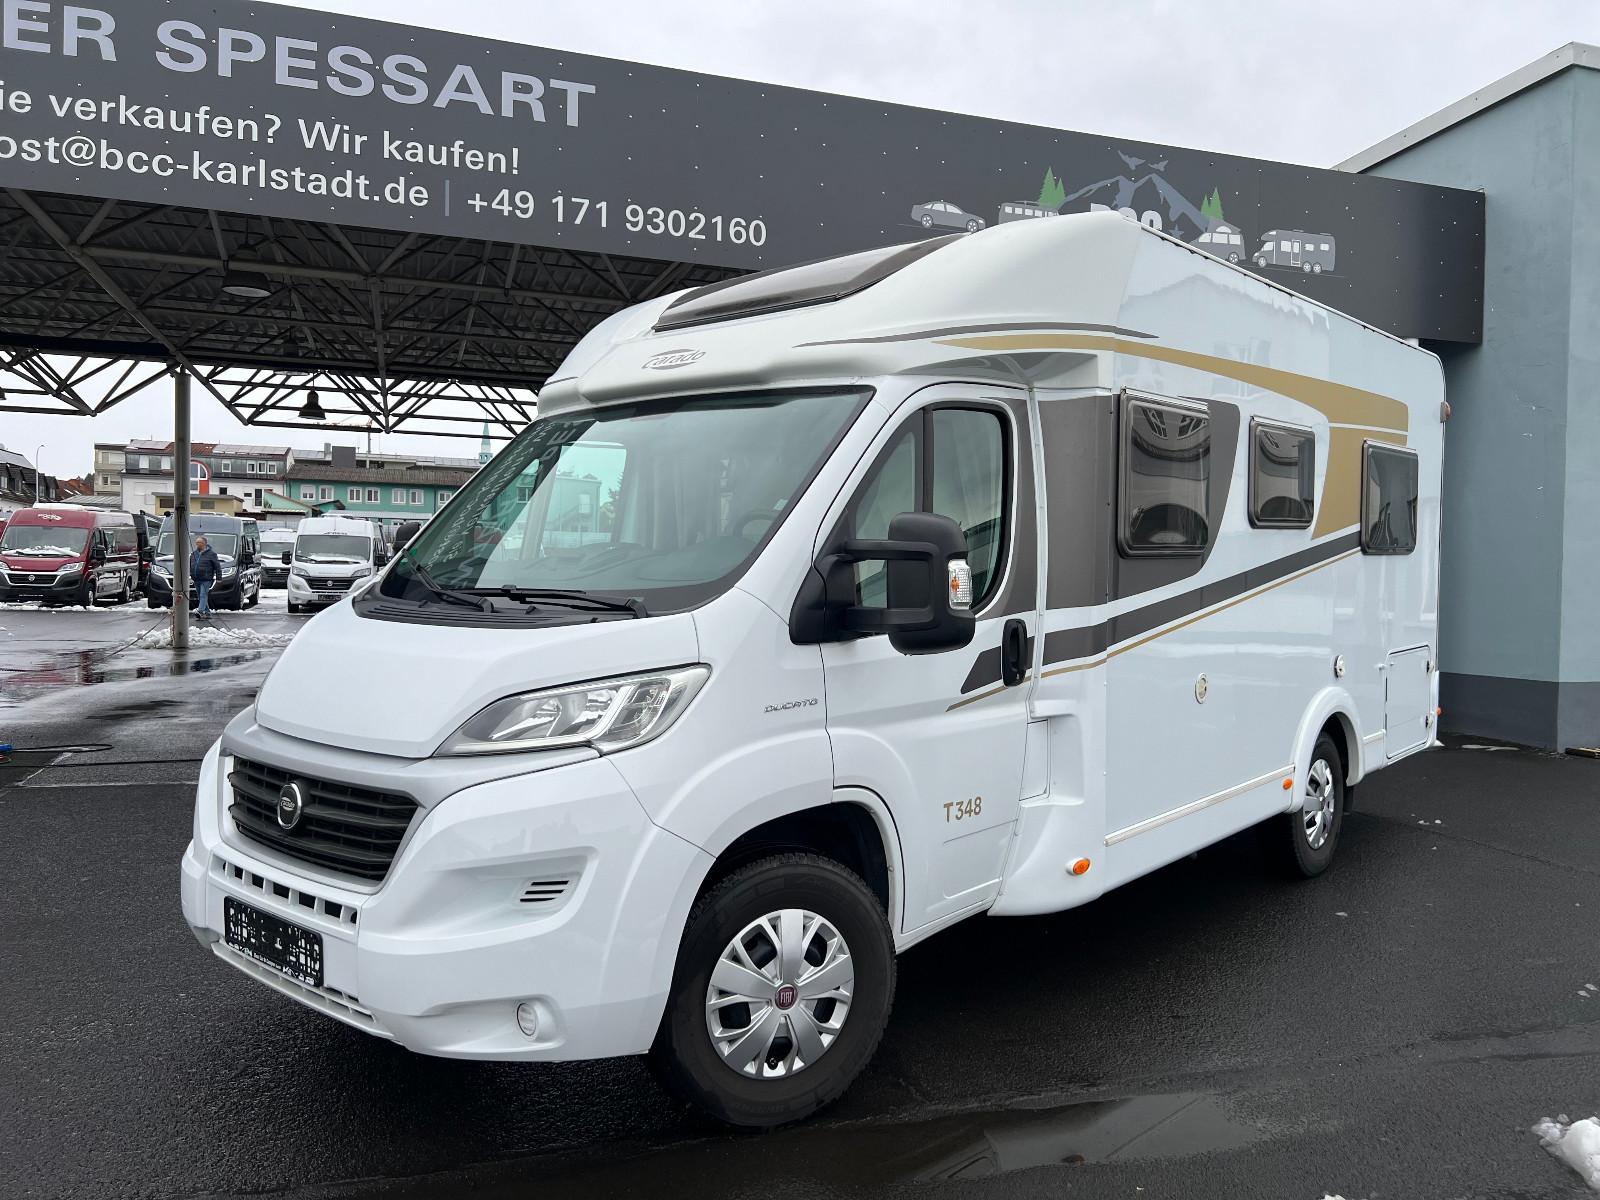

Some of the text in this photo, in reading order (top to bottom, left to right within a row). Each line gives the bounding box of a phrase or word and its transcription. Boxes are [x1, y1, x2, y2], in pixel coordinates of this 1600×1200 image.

[4, 0, 596, 127] ER SPESSART
[49, 95, 281, 143] verkaufen?
[298, 119, 367, 155] Wir
[383, 131, 519, 175] kaufen!
[0, 136, 767, 247] ost@bcc-karlstadt.de +49 171 9302160
[763, 698, 818, 713] DUCATO
[780, 991, 793, 1004] FIAT
